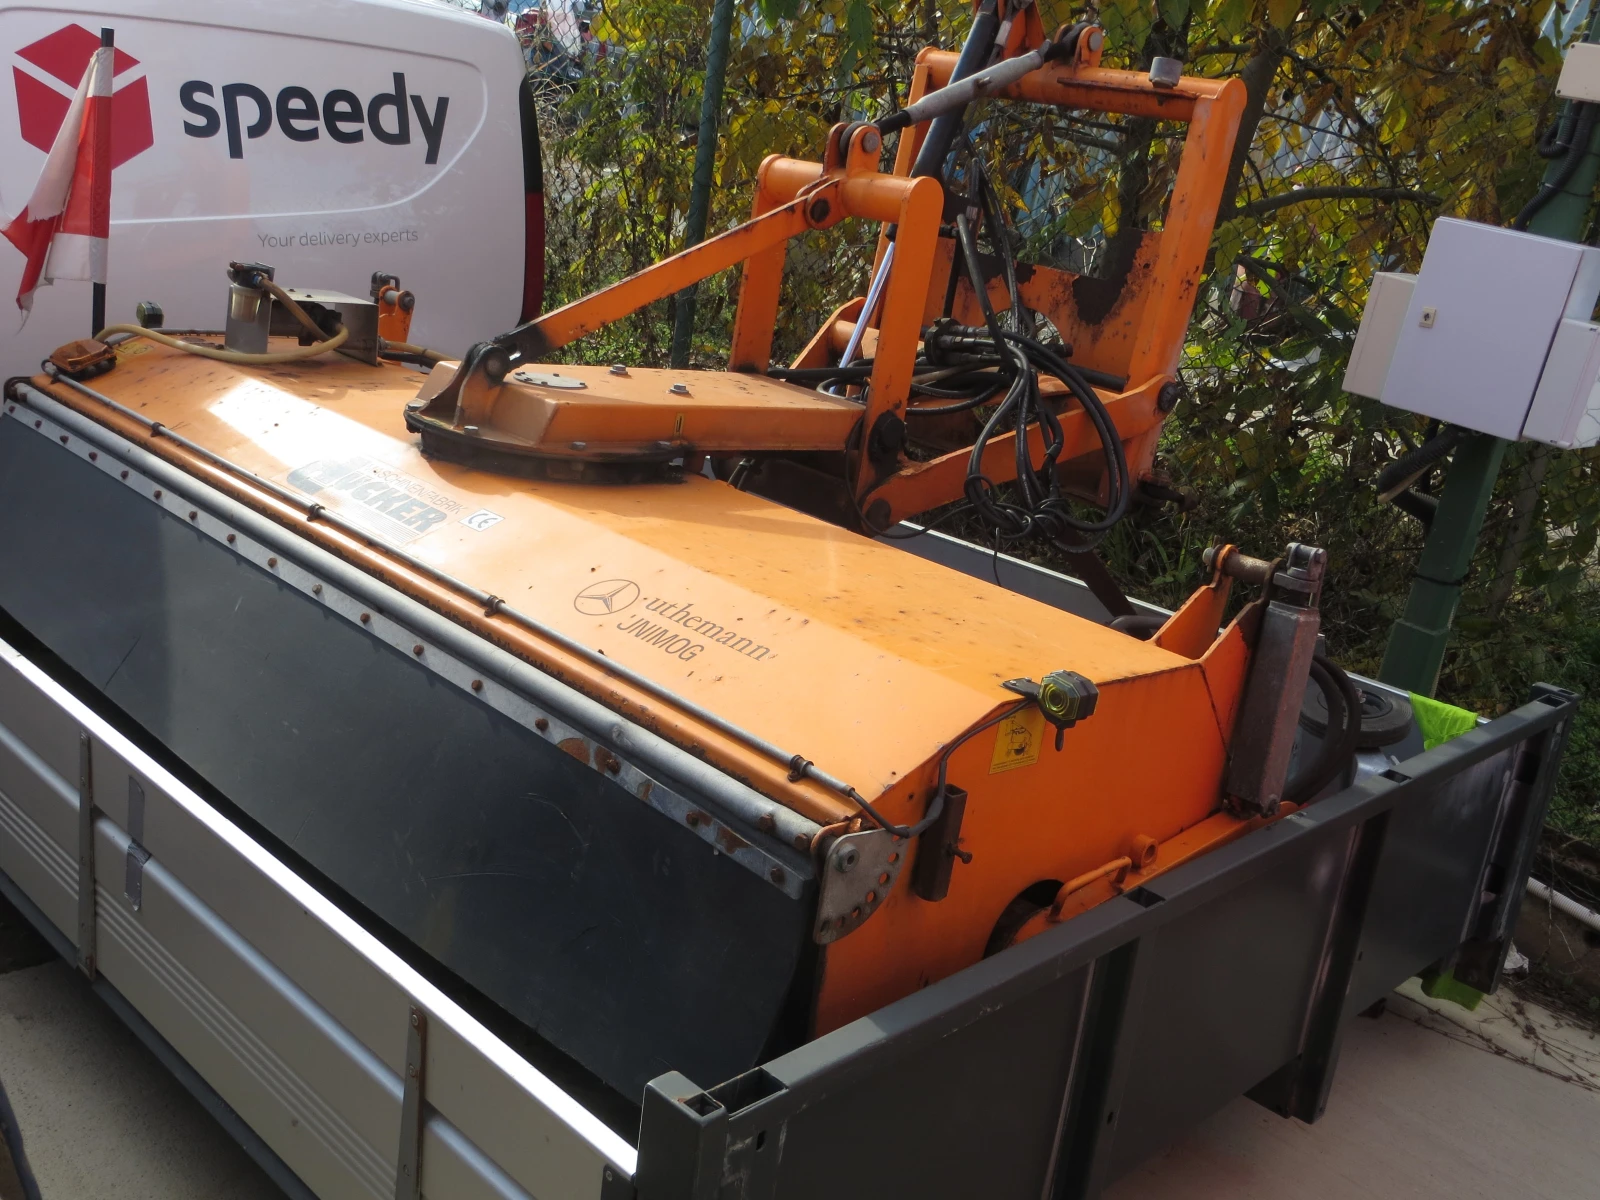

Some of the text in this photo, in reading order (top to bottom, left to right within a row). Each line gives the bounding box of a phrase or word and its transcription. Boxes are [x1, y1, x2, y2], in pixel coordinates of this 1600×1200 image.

[180, 72, 449, 164] speedy
[258, 229, 418, 249] Your delivery experts
[368, 464, 468, 515] SCHINENFABRIK
[467, 512, 498, 529] CE
